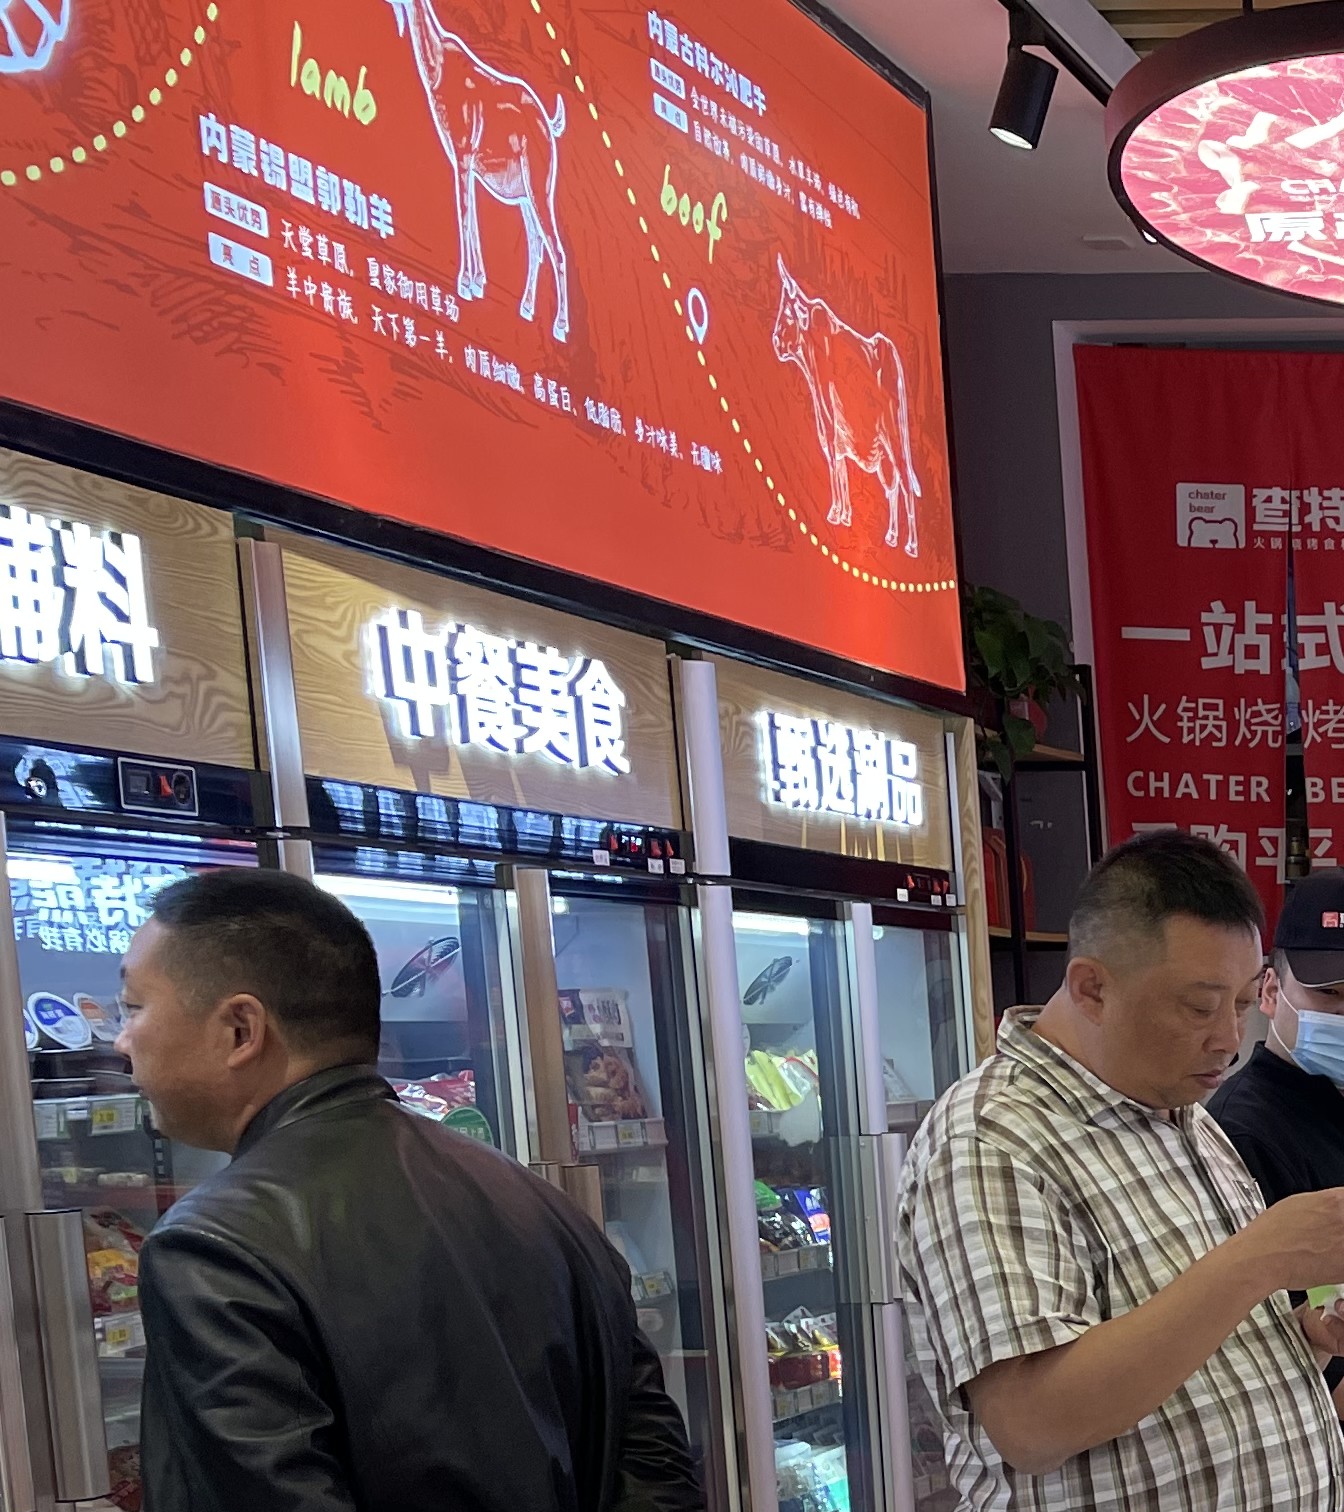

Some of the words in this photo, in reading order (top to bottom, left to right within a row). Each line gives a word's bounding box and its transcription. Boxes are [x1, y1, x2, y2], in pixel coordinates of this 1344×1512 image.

[289, 22, 378, 126] lamb
[199, 113, 395, 239] 内蒙锡盟郭勒羊
[367, 605, 630, 776] 中餐美食
[1126, 770, 1271, 803] CHATER
